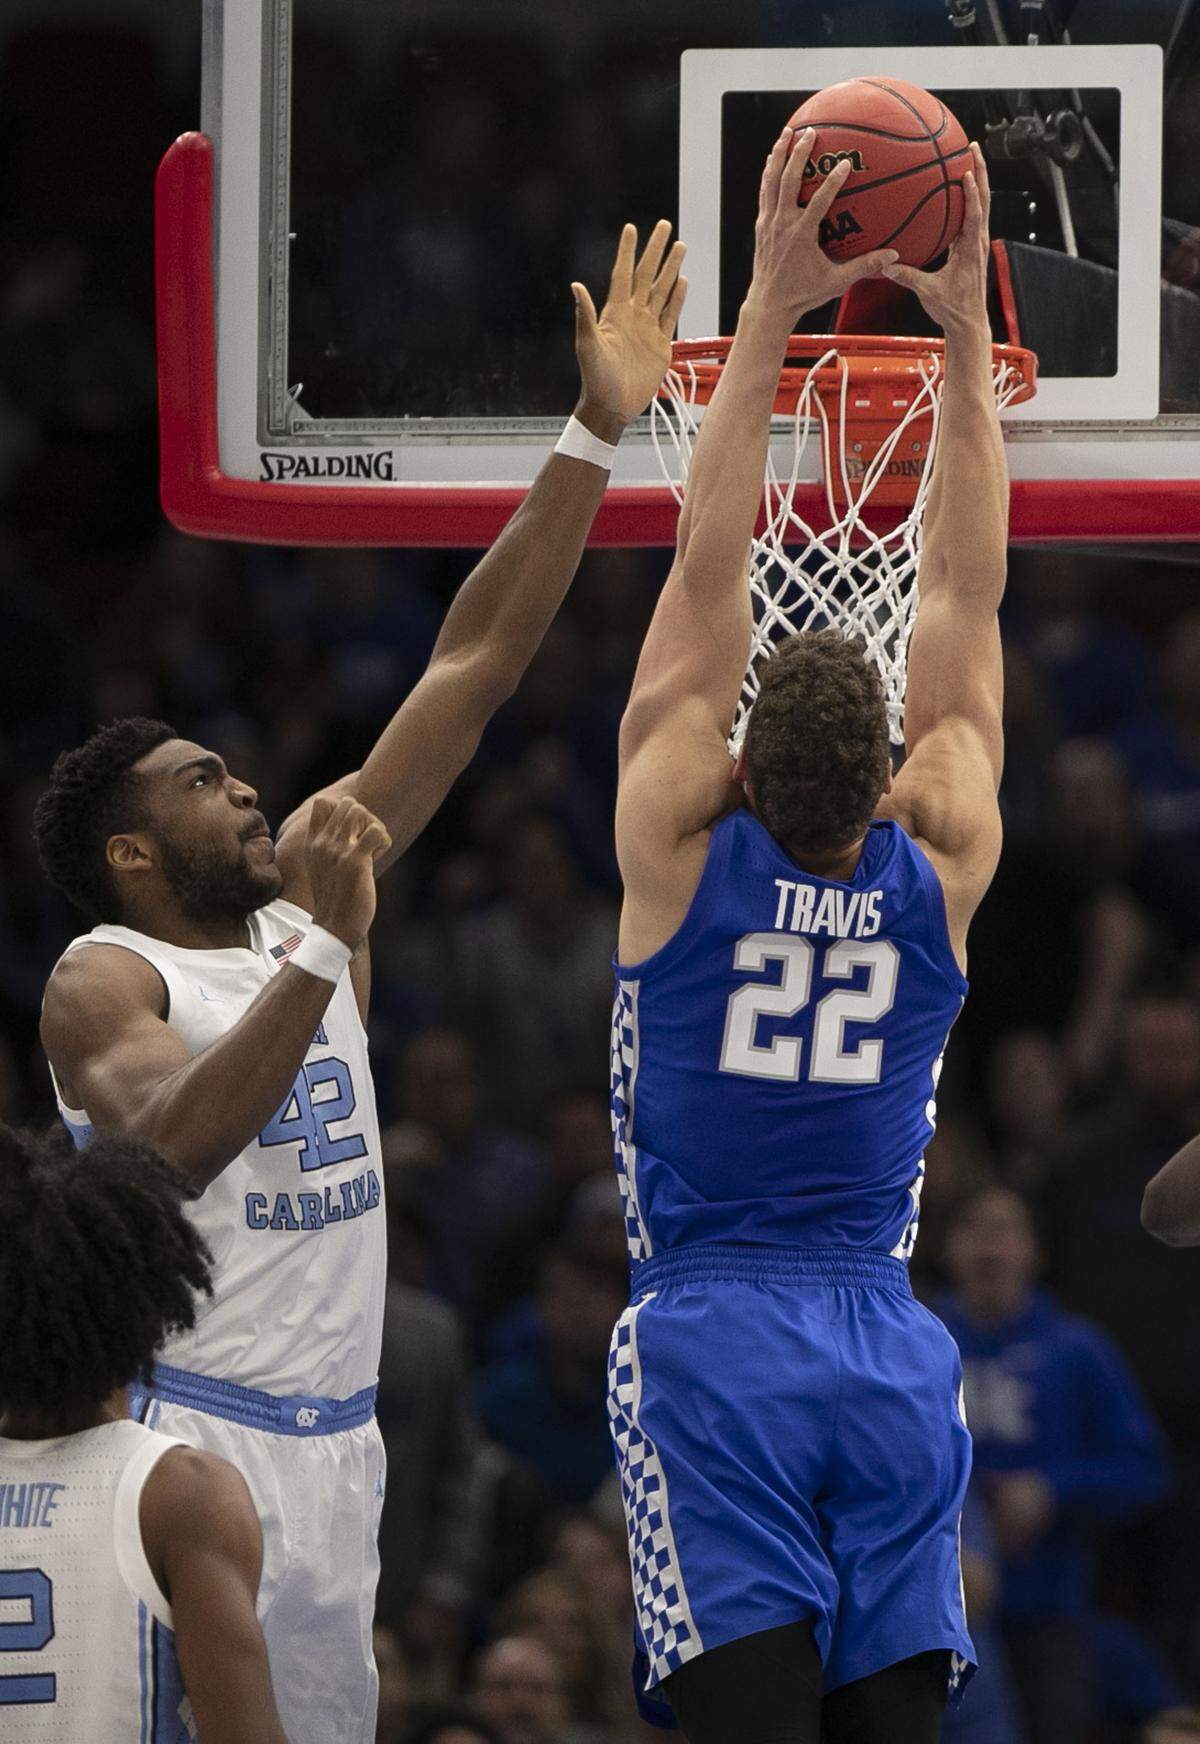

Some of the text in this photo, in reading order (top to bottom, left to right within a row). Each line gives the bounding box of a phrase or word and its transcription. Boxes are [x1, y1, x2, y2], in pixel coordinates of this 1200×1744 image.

[802, 148, 863, 180] son
[818, 210, 863, 244] AA
[260, 450, 393, 482] SPALDING
[774, 878, 883, 938] TRAVIS
[718, 932, 901, 1083] 22
[258, 1056, 369, 1172] 42
